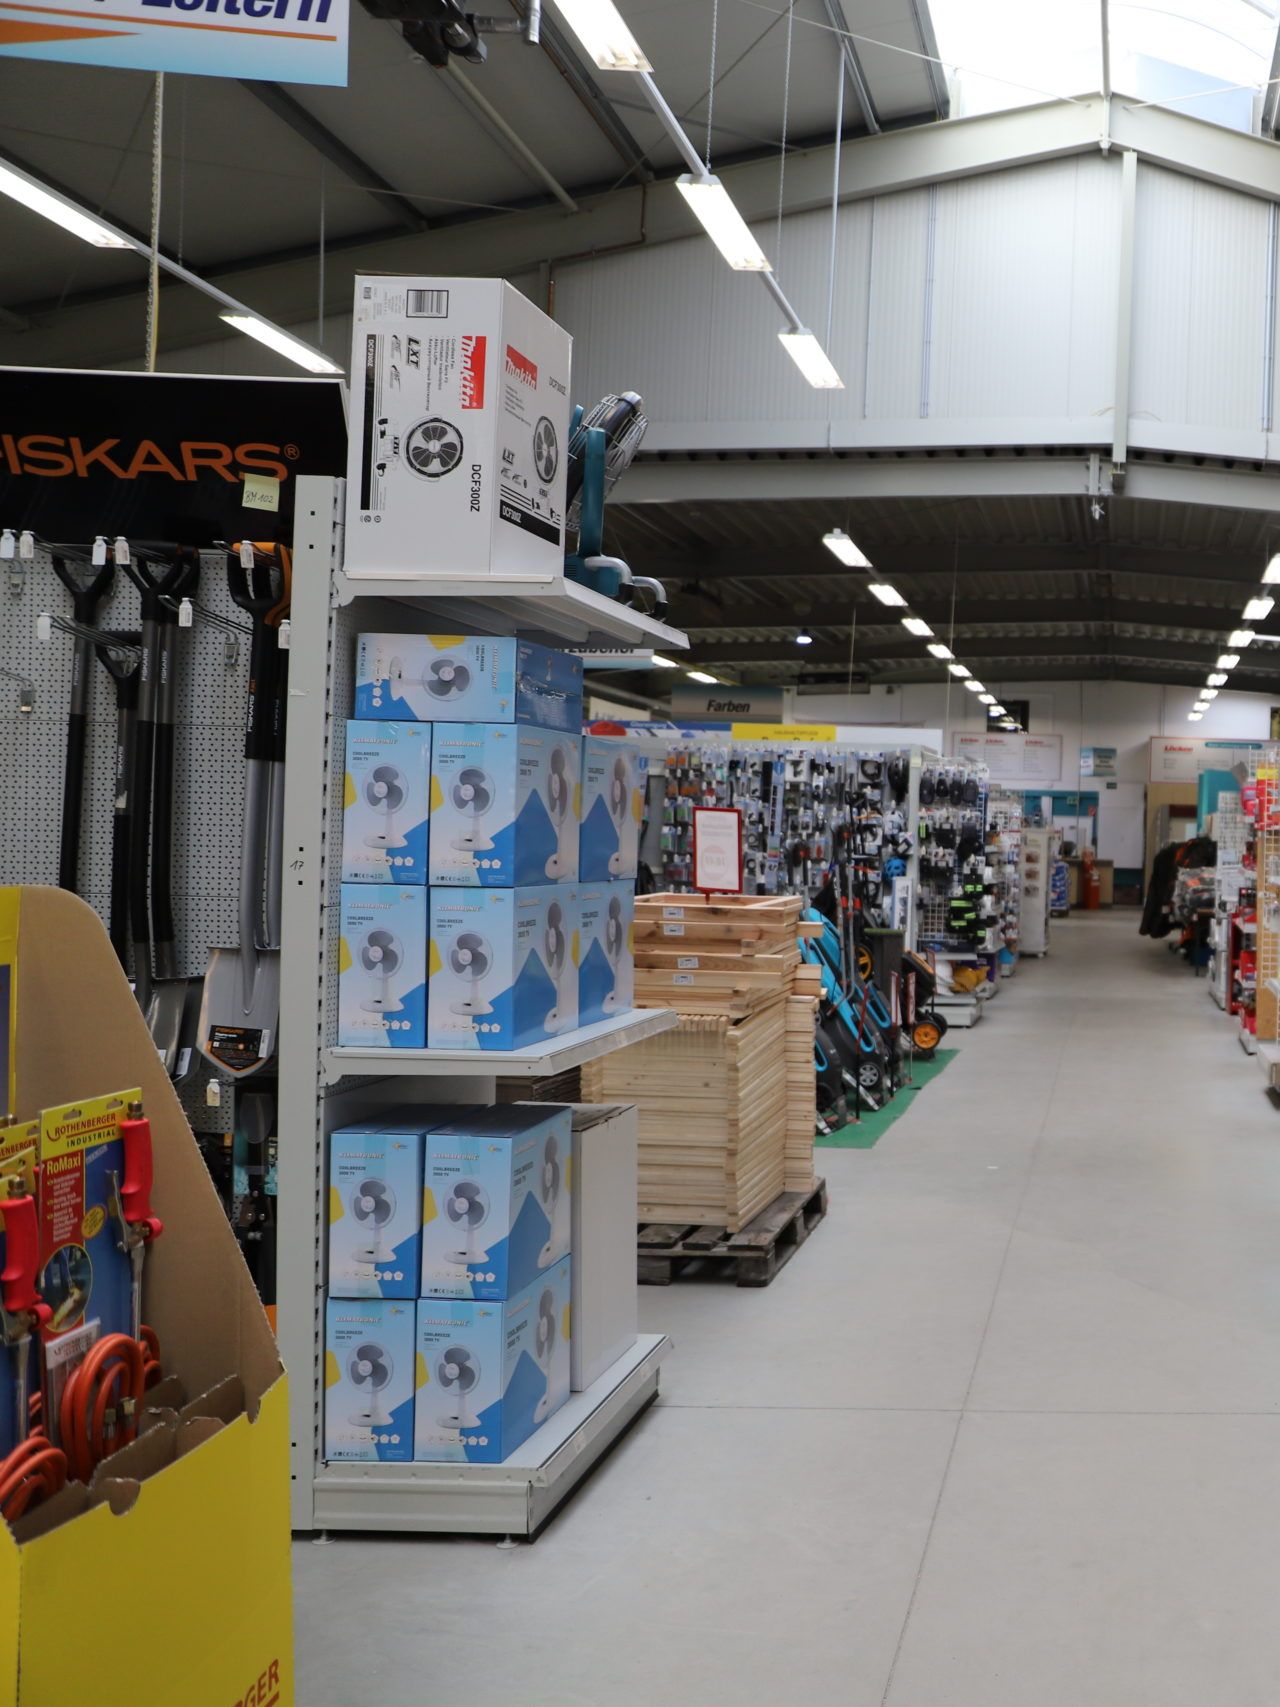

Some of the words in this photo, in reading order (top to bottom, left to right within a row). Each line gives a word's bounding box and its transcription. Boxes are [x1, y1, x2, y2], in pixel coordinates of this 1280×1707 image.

[367, 339, 375, 367] DCF300Z
[406, 337, 420, 368] LXT
[0, 434, 289, 484] ISKARS
[470, 464, 482, 512] DCF300Z
[706, 699, 751, 713] Farben
[54, 1113, 116, 1137] ROTHENBERGER
[67, 1129, 115, 1148] INDUSTRIAL
[47, 1152, 81, 1175] RoMaxi
